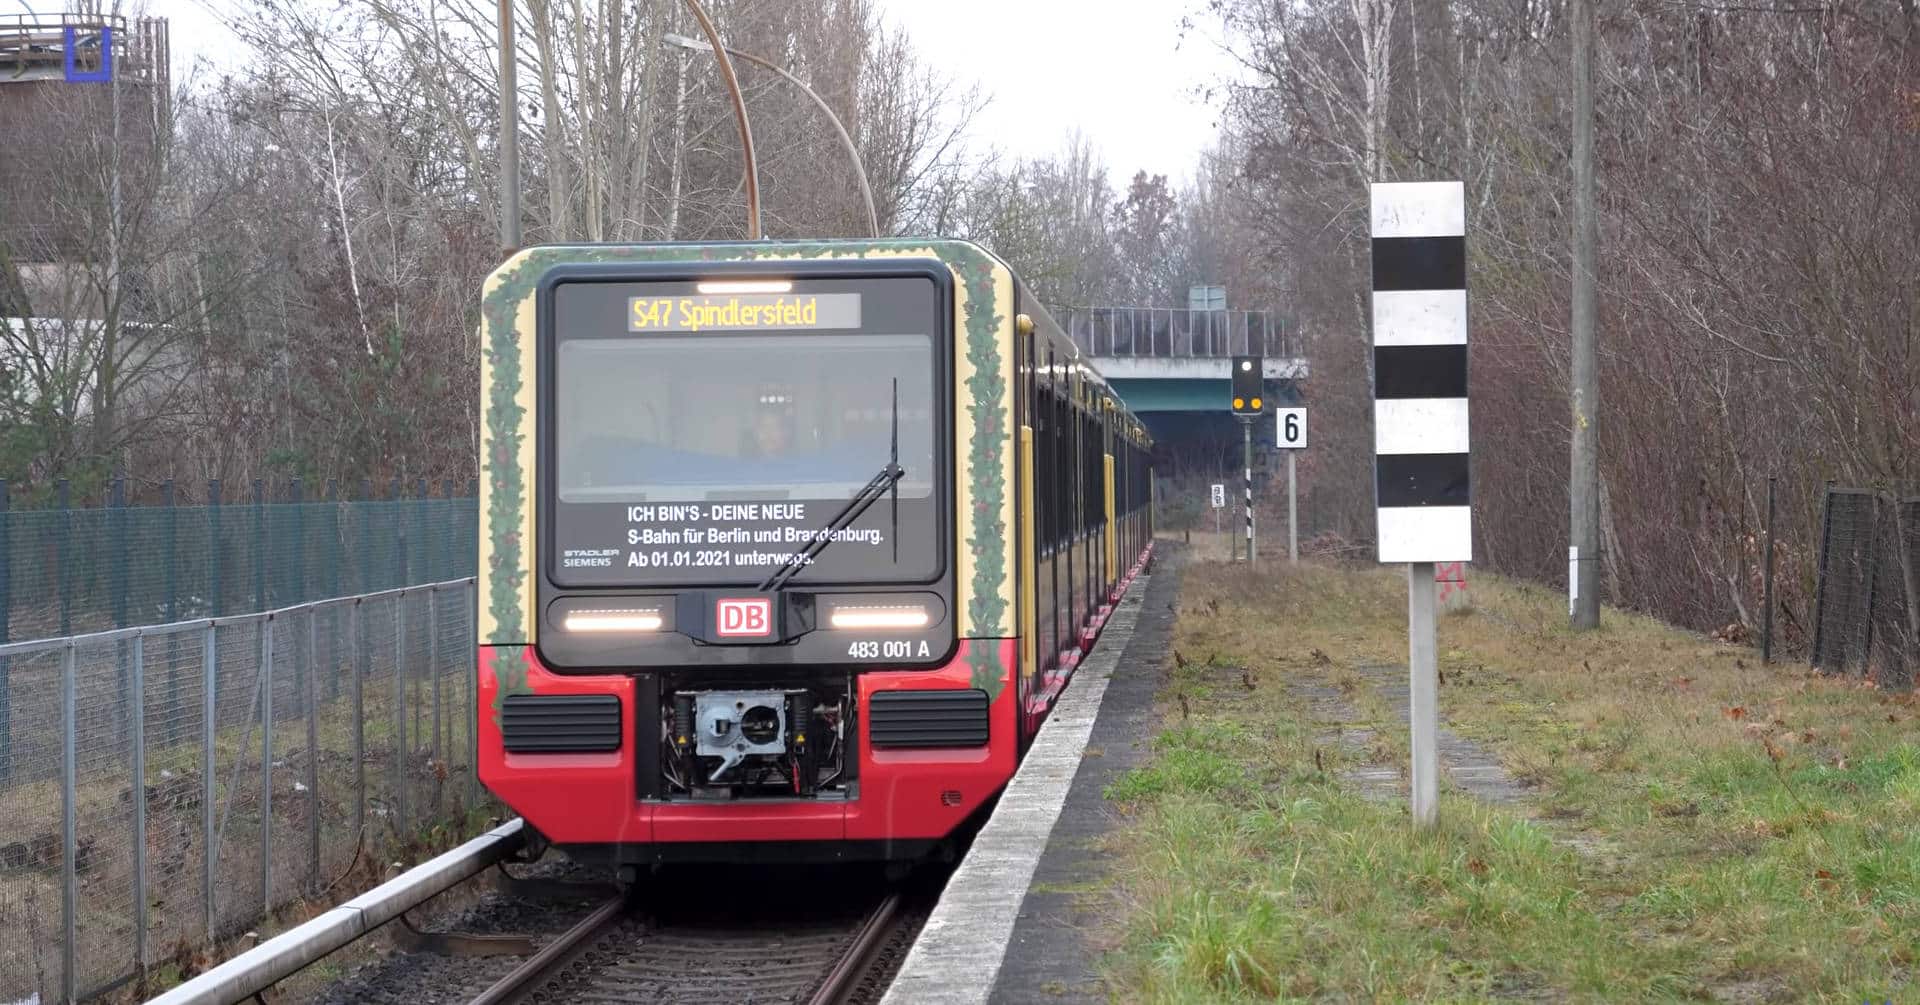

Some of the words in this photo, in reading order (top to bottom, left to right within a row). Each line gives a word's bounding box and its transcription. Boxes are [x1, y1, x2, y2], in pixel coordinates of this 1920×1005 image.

[633, 299, 673, 328] S47
[679, 297, 817, 332] Spindlersfeld
[1284, 413, 1299, 442] 6
[627, 506, 655, 522] ICH
[658, 505, 700, 521] BIN'S
[711, 505, 758, 521] DEINE
[761, 504, 805, 520] NEUE
[627, 529, 680, 544] S-Bahn
[683, 528, 704, 543] für
[707, 527, 750, 543] Berlin
[754, 527, 781, 542] und
[784, 526, 884, 545] Brandenburg.
[563, 549, 620, 557] STADLER
[564, 557, 612, 567] SIEMENS
[627, 552, 648, 567] Ab
[651, 550, 731, 566] 01.01.2021
[734, 552, 815, 567] unterwegs.
[724, 605, 765, 630] DB
[848, 642, 878, 658] 483
[883, 641, 912, 657] 001
[917, 641, 930, 657] A
